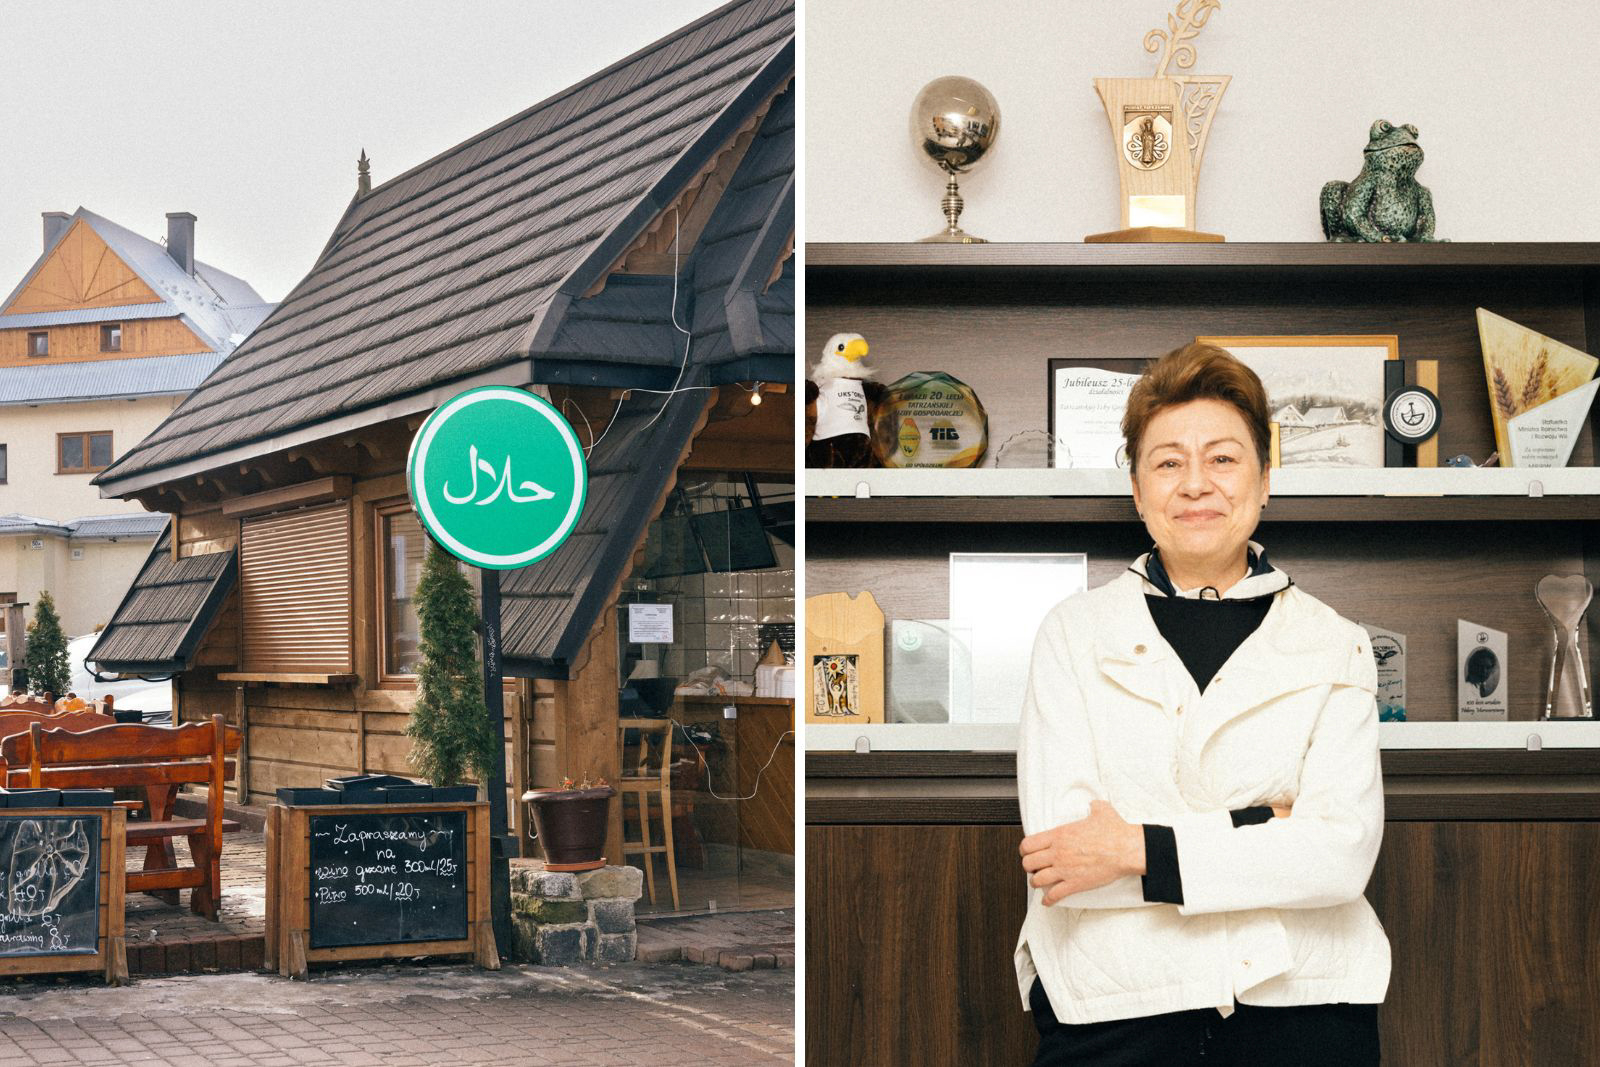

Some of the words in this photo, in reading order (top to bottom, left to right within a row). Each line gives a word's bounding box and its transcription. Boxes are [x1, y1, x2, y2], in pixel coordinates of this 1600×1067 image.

[1062, 377, 1108, 389] Jubileusz
[929, 391, 943, 400] 20
[443, 444, 556, 506] حلال
[333, 824, 427, 852] Zapraszamy
[376, 849, 396, 861] na
[355, 865, 398, 883] grzane
